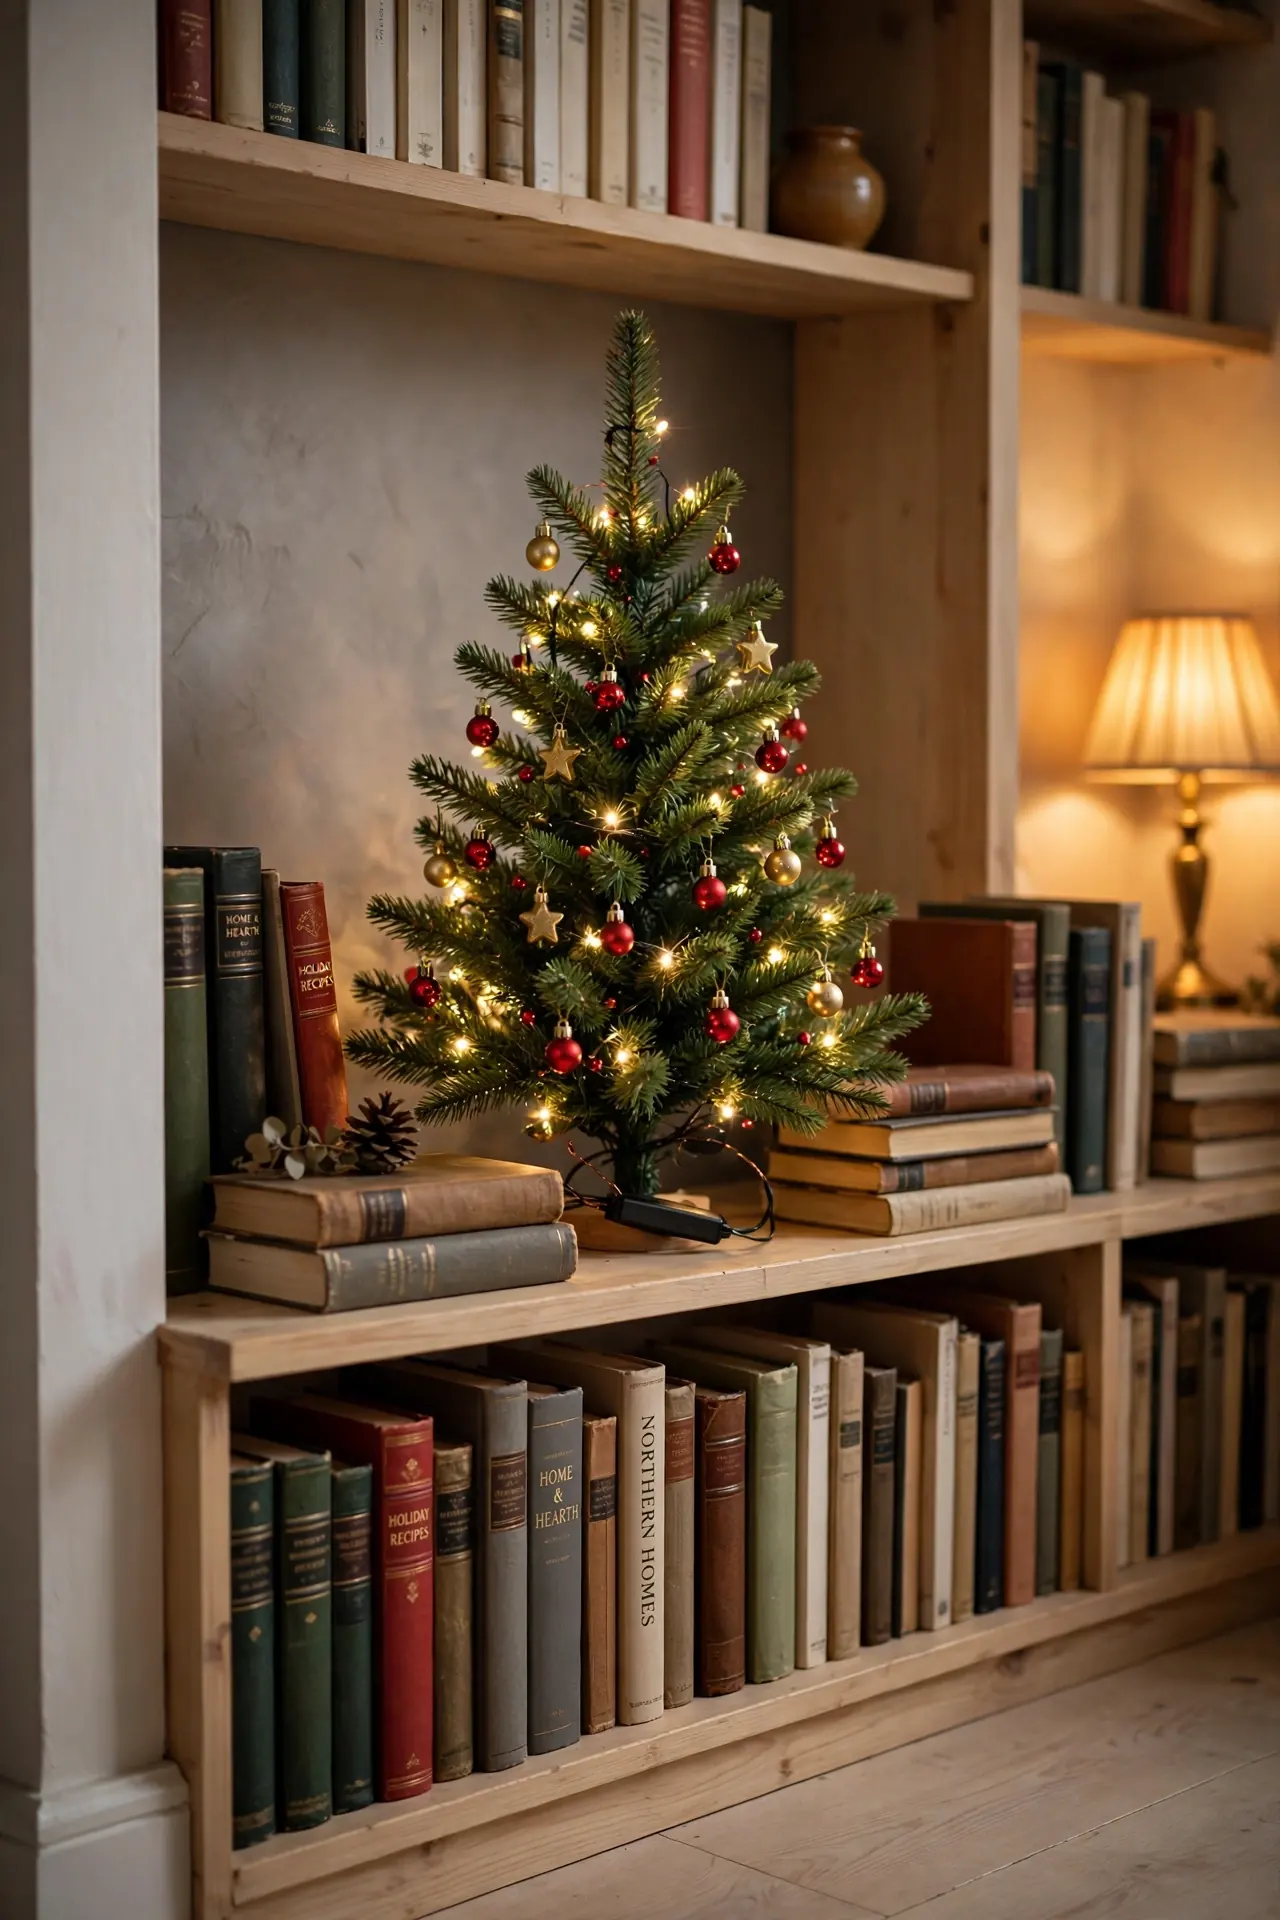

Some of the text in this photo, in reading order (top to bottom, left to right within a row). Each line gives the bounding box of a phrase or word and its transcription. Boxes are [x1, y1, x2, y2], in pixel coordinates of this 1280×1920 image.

[225, 914, 252, 924] HOME
[225, 926, 260, 938] HEARTH
[539, 1465, 573, 1487] HOME
[553, 1487, 563, 1503] &
[388, 1507, 430, 1528] HOLIDAY
[535, 1504, 579, 1529] HEARTH
[641, 1415, 655, 1627] NORTHERN HOMES
[389, 1526, 429, 1547] RECIPES
